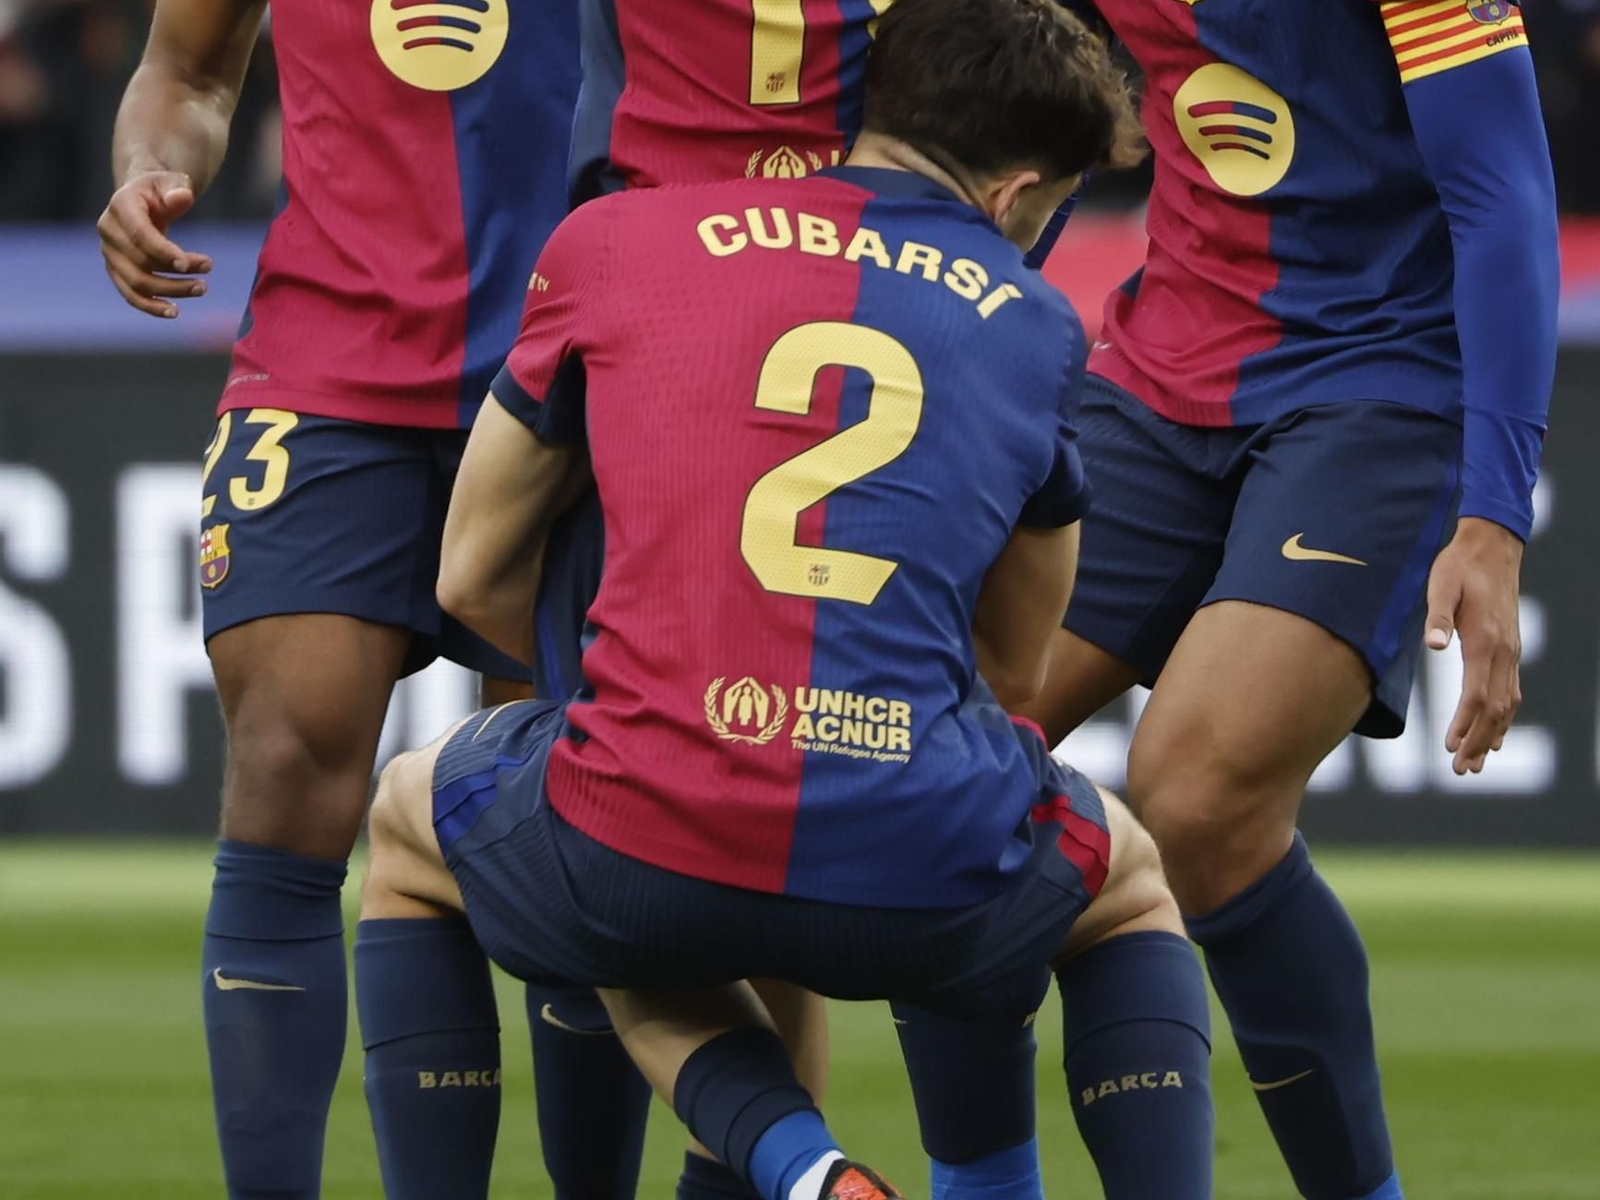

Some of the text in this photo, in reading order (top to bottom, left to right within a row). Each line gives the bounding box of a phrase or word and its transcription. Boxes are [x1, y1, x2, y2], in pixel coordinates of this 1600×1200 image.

[697, 207, 1022, 319] CUBARSÍ
[740, 321, 924, 605] 2
[794, 686, 911, 726] UNHCR
[791, 714, 911, 751] ACNUR
[792, 739, 811, 751] The
[812, 741, 829, 753] UN
[871, 750, 910, 764] Agency
